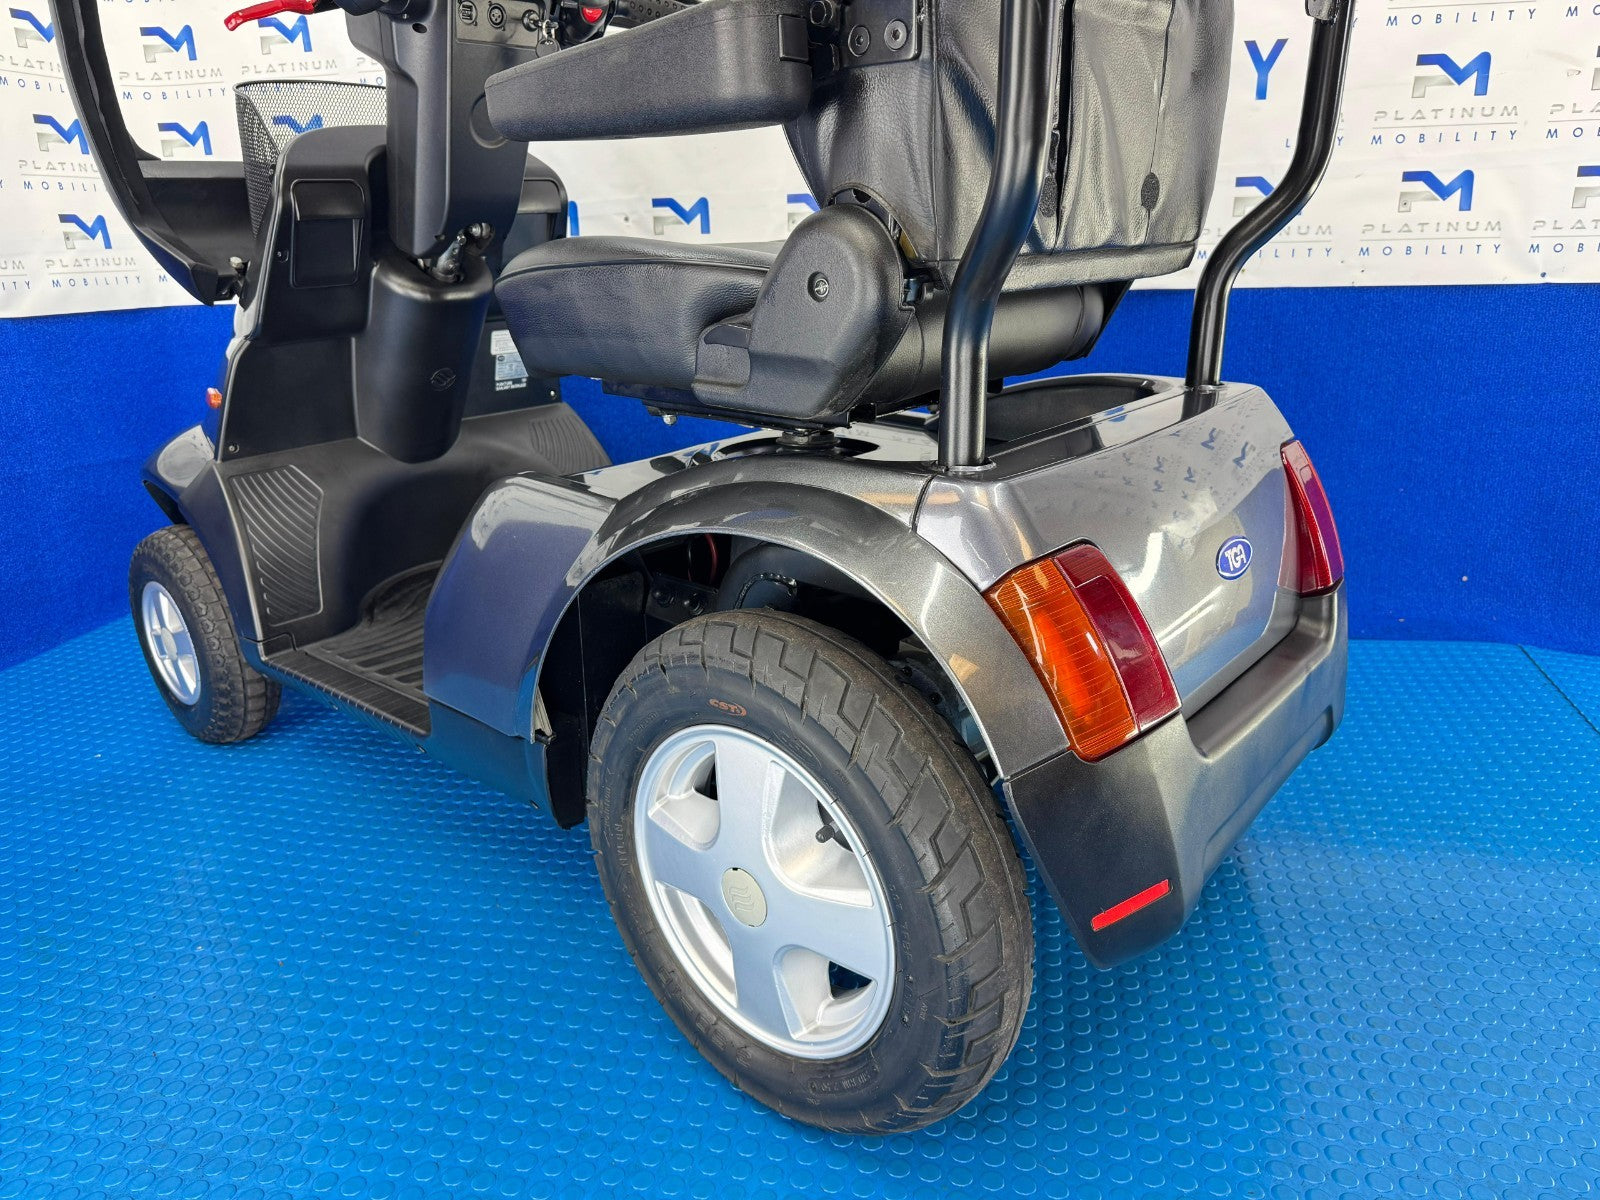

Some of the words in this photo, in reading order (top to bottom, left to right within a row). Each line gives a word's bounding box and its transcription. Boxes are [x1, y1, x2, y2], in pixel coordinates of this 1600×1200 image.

[1386, 8, 1536, 27] MOBILITY
[241, 59, 338, 76] PLATINUM
[119, 68, 223, 81] PLATINUM
[0, 76, 65, 94] MOBIL
[122, 87, 226, 100] MOBILITY
[1374, 105, 1519, 122] PLATINUM
[1371, 130, 1518, 145] MOBILITY
[19, 159, 100, 173] PLATINU
[24, 180, 97, 192] MOBILI
[1361, 221, 1502, 235] PLATINUM
[1533, 219, 1600, 231] PLAT
[1197, 247, 1332, 259] MILITY
[1358, 244, 1500, 257] MOBILITY
[45, 257, 137, 269] PLATINUM
[52, 275, 141, 288] MOBILITY
[1224, 544, 1247, 571] TGA
